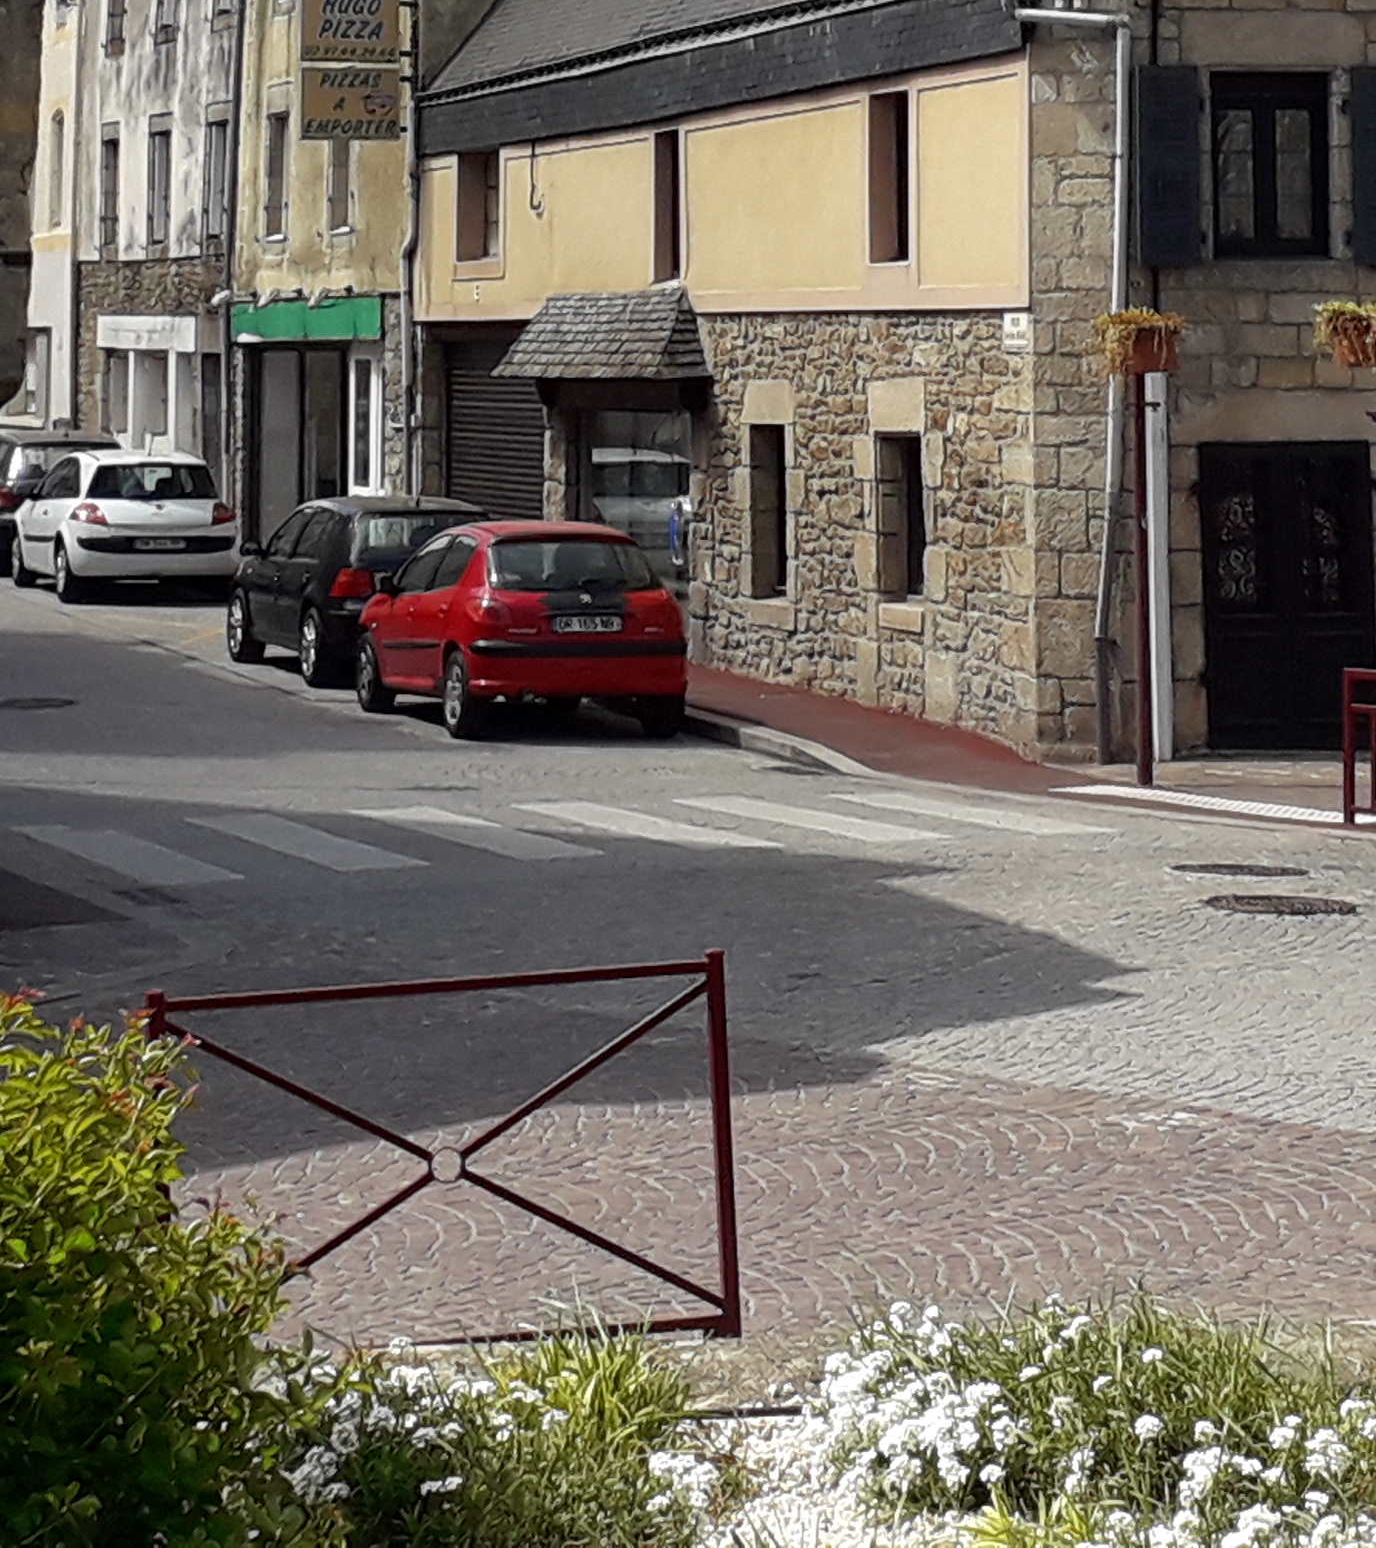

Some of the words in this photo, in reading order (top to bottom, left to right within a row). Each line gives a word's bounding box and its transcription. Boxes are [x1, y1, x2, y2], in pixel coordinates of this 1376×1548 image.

[318, 19, 383, 39] PIZZA
[319, 72, 382, 88] PIZZAS
[332, 96, 346, 111] A
[304, 119, 397, 136] EMPORTER
